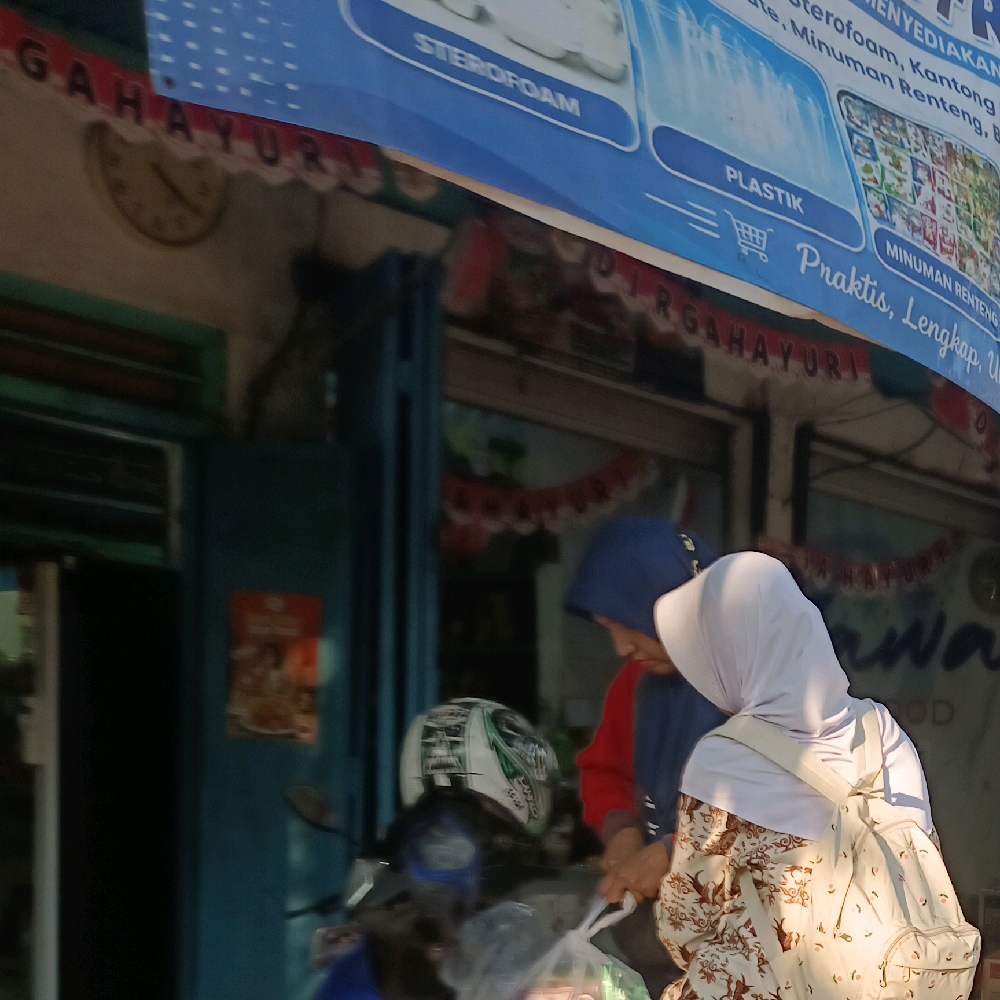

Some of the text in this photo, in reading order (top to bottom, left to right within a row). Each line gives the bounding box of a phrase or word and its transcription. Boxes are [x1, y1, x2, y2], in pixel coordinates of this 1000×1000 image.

[413, 31, 580, 118] STEROFOAM
[791, 19, 895, 90] Minuman
[900, 78, 989, 139] Renteng,
[909, 58, 995, 116] Kantong
[726, 165, 804, 214] PLASTIK
[886, 240, 999, 328] MINUMAN RENTENG
[901, 296, 982, 374] Lengkap,
